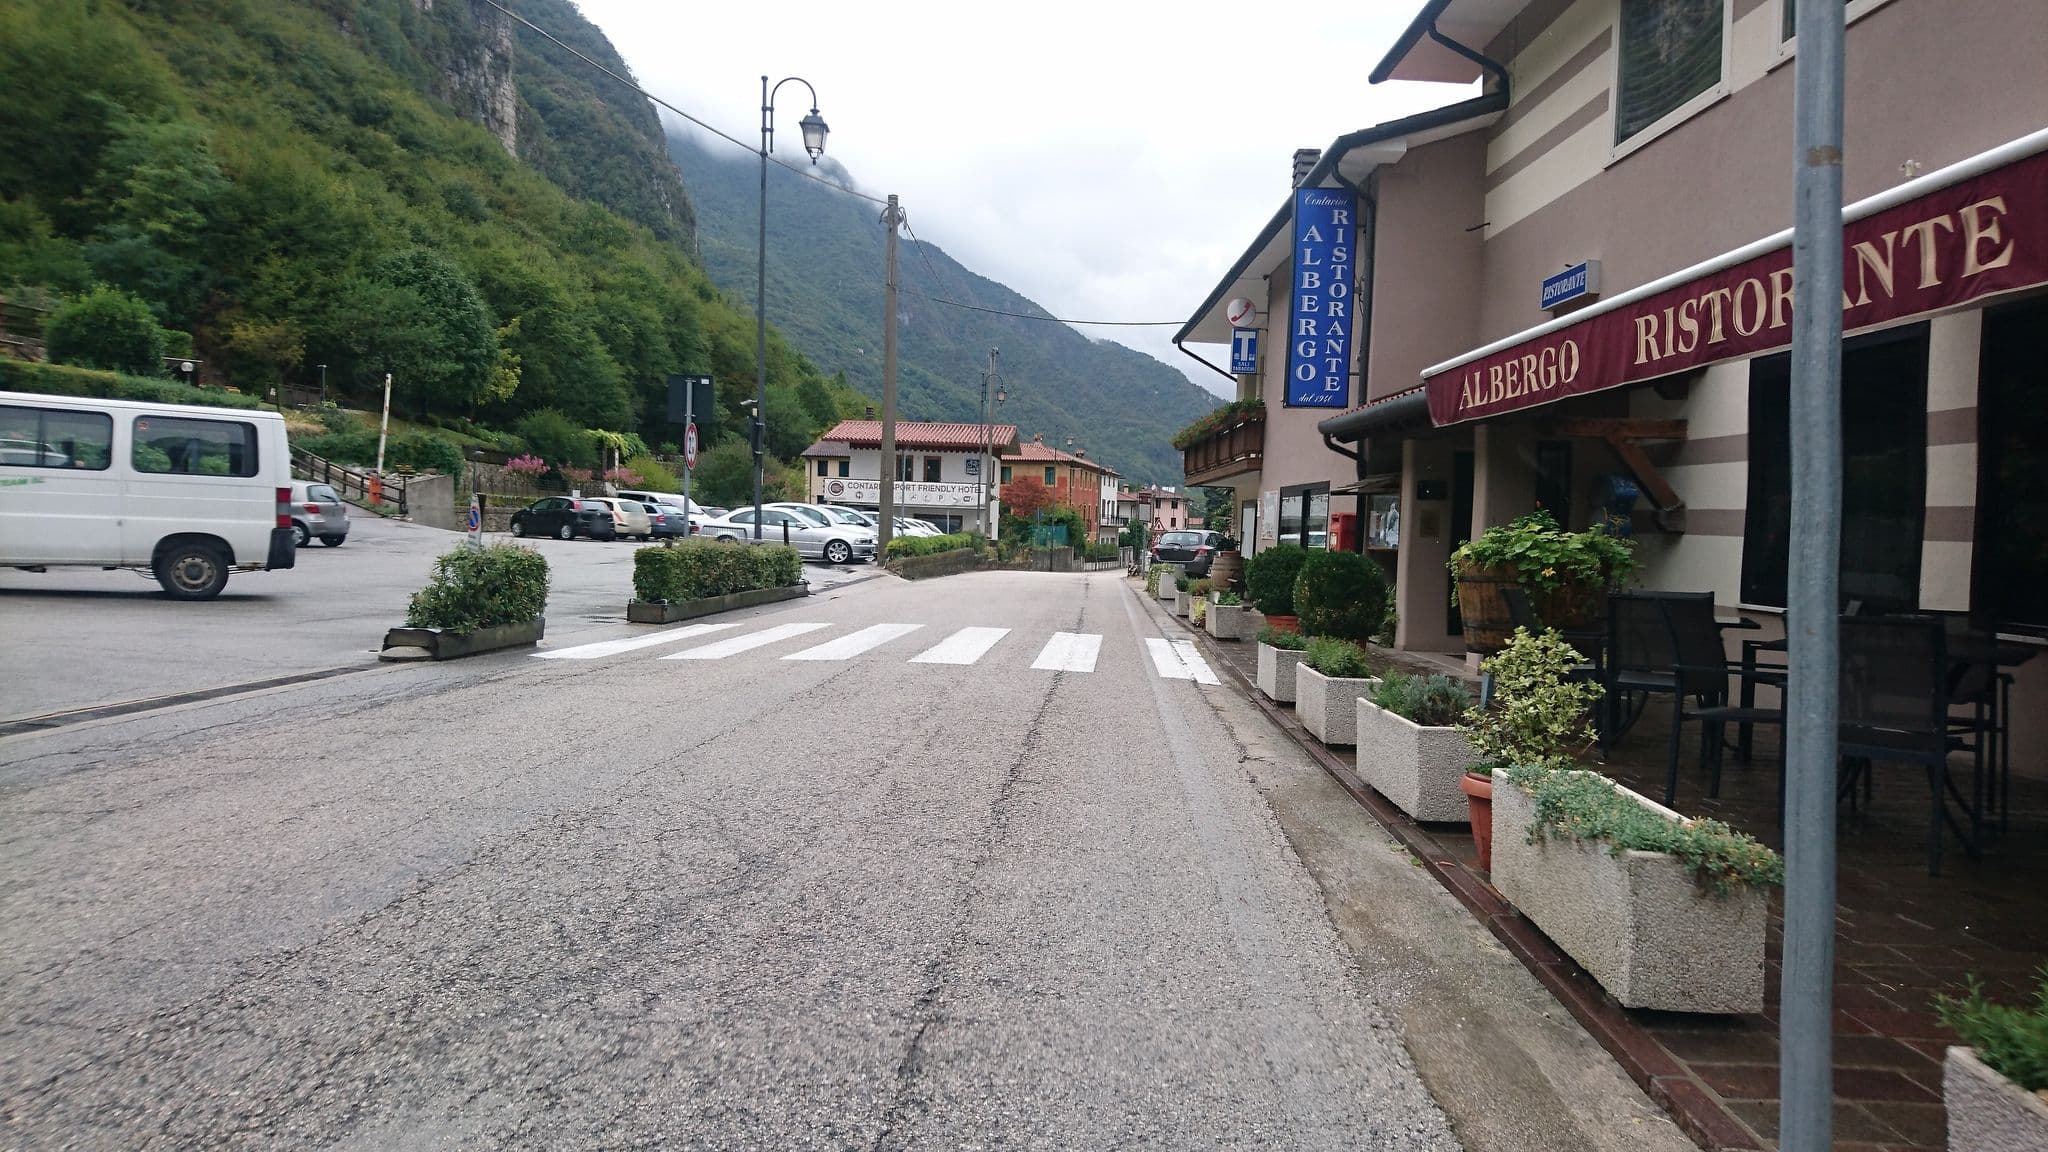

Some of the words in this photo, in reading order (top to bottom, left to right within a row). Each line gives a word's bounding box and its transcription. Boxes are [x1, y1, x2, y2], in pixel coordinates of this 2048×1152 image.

[1295, 225, 1323, 381] ALBERGO
[1324, 209, 1349, 391] RISTORANTE
[1459, 340, 1580, 410] ALBERGO
[1634, 195, 2014, 365] RISTORNTE
[1543, 270, 1586, 301] RISTORANTE
[918, 484, 956, 492] FRIENDLY
